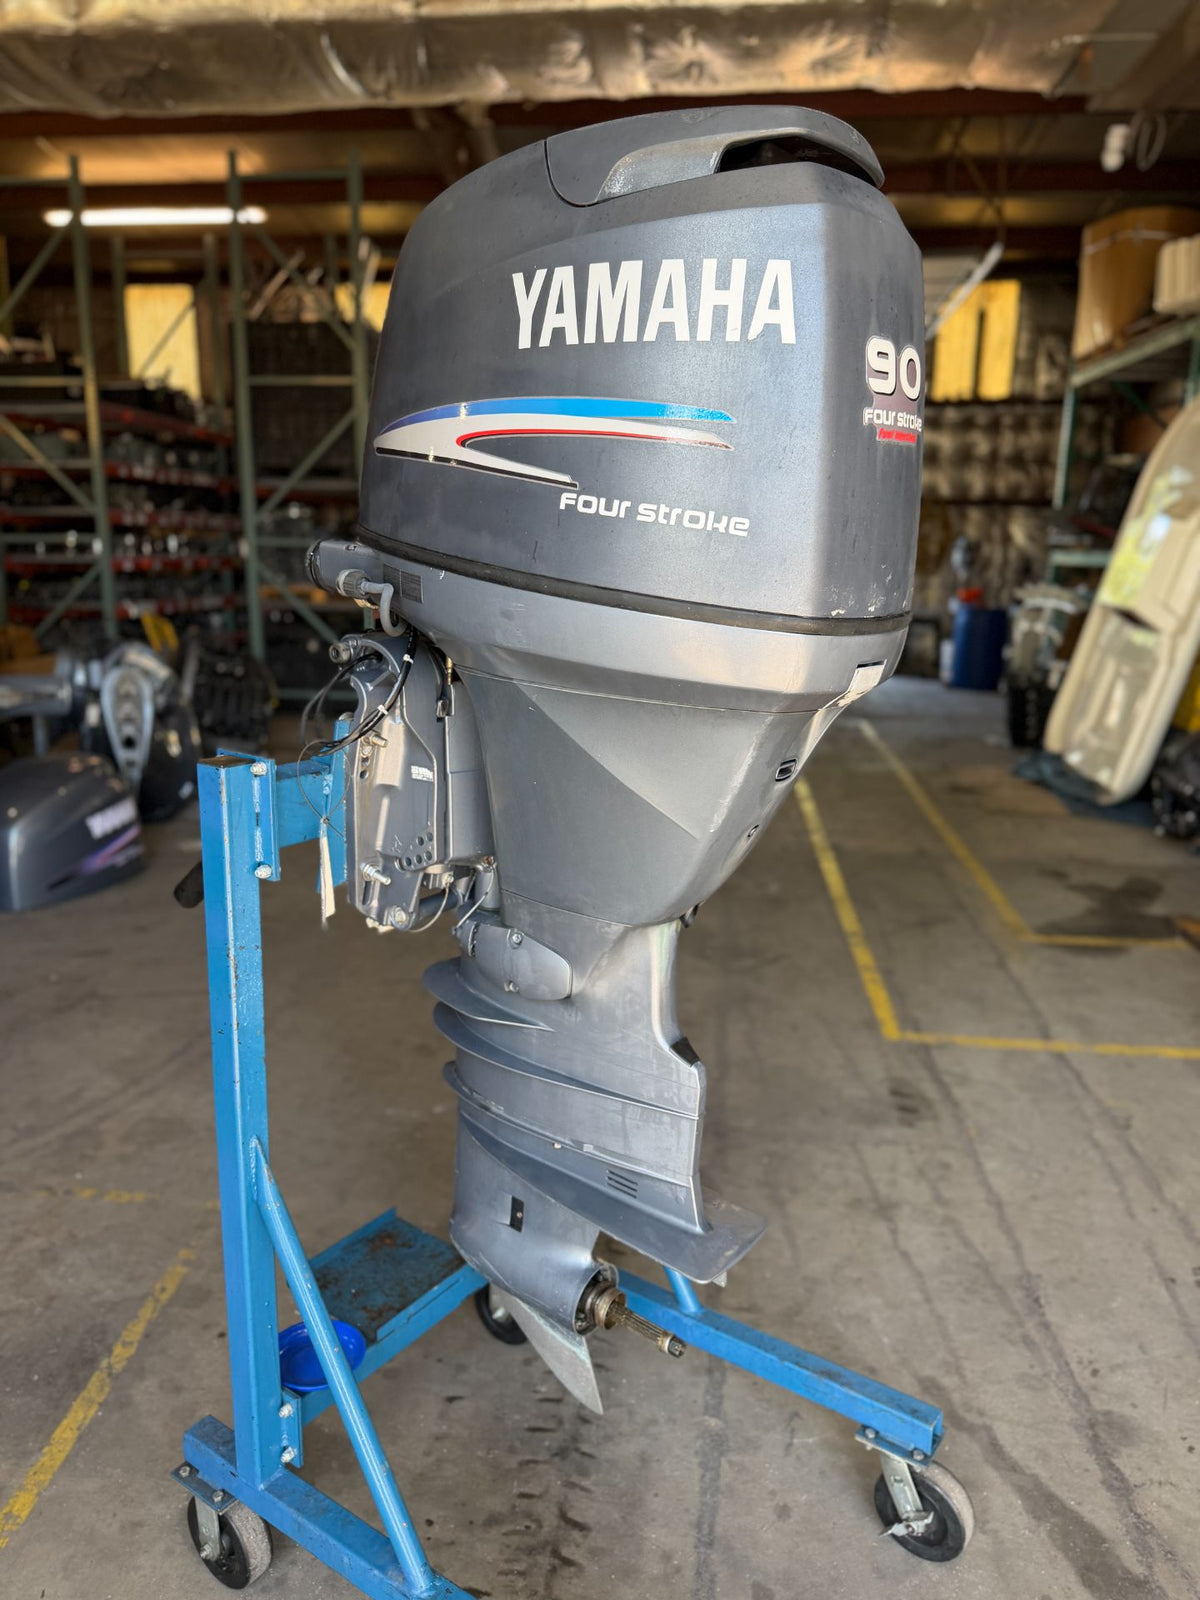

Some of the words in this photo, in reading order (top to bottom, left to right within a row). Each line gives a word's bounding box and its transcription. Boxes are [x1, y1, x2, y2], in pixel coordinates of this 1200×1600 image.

[512, 258, 797, 349] YAMAHA
[866, 336, 921, 401] 90
[864, 408, 895, 426] Four
[559, 492, 631, 518] Four
[636, 503, 750, 537] stroke
